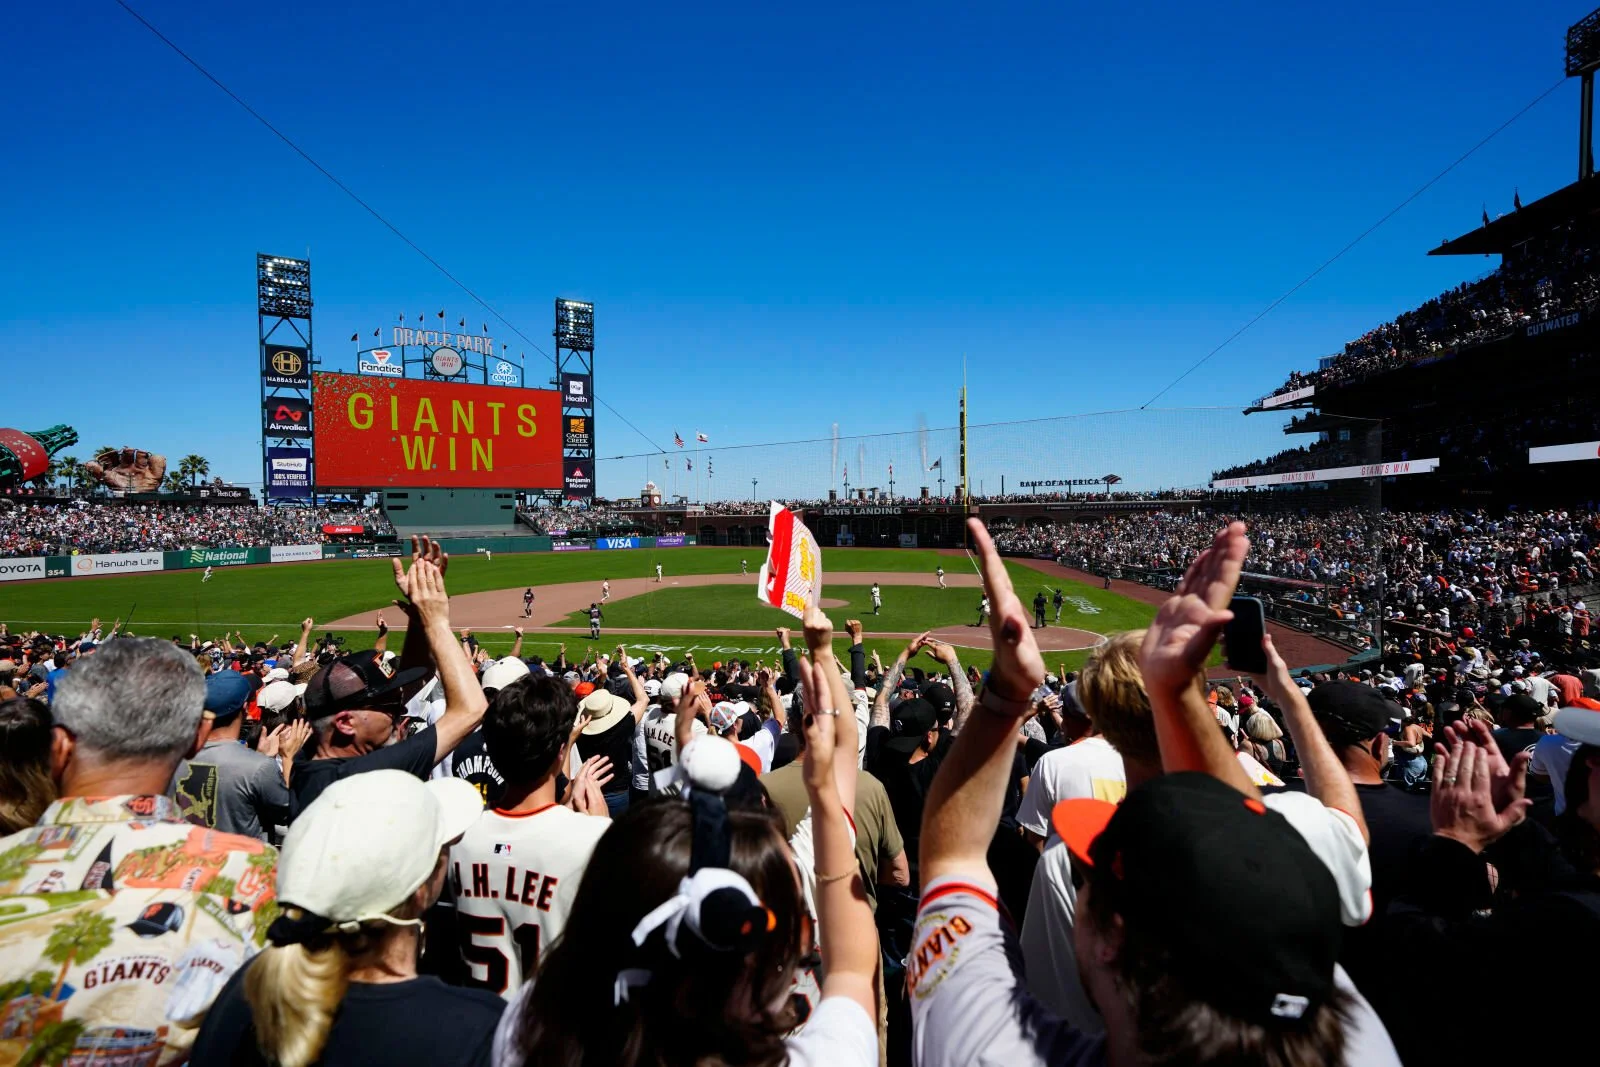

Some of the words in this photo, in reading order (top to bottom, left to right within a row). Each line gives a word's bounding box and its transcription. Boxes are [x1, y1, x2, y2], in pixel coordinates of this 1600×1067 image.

[1527, 312, 1580, 336] CUTWATER
[393, 326, 452, 349] ORACLE
[456, 333, 494, 357] PARK
[435, 354, 459, 363] GIANTS
[441, 361, 454, 369] WIN
[361, 361, 402, 374] Fanatics
[267, 376, 293, 384] HABBAS
[493, 374, 517, 383] coupa
[565, 394, 588, 403] Health
[348, 392, 537, 438] GIANTS
[269, 422, 308, 431] Airwallex
[401, 435, 494, 472] WIN
[1281, 471, 1301, 481] GIANTS
[1303, 471, 1316, 481] WIN
[1361, 465, 1389, 476] GIANTS
[1393, 463, 1410, 473] WIN
[1058, 478, 1100, 486] AMERICA
[853, 507, 901, 515] LANDING
[607, 538, 632, 549] VISA
[205, 549, 249, 562] National
[96, 560, 138, 569] Hanwha
[141, 558, 159, 566] Life
[658, 730, 675, 747] LEE
[453, 862, 499, 898] J.H.
[505, 866, 558, 912] LEE
[457, 912, 541, 997] 51
[190, 957, 225, 974] GIANTS
[84, 960, 171, 990] GIANTS
